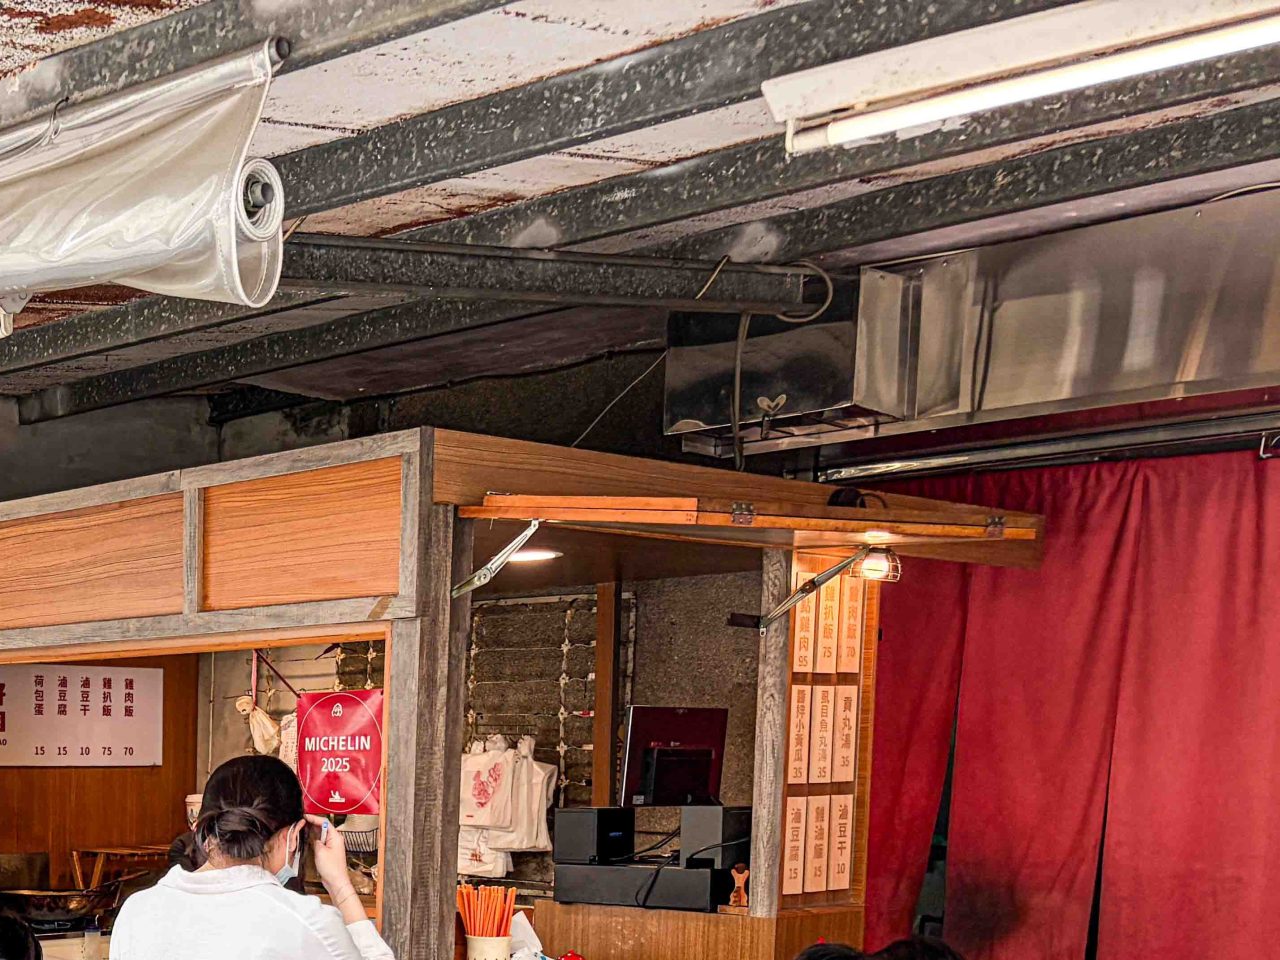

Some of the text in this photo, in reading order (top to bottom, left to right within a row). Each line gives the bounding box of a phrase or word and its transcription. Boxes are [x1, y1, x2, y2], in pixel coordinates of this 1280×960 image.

[822, 646, 832, 658] 75
[846, 646, 856, 658] 70
[798, 655, 808, 667] 95
[34, 675, 45, 716] 荷包蛋
[57, 676, 68, 716] 滷豆腐
[80, 677, 91, 716] 滷豆干
[102, 677, 112, 717] 雞扒飯
[124, 678, 134, 717] 雞肉飯
[305, 736, 370, 751] MICHELIN
[34, 746, 45, 756] 15
[57, 746, 68, 756] 15
[80, 746, 90, 756] 10
[102, 746, 112, 756] 75
[124, 746, 134, 756] 70
[321, 757, 350, 772] 2025
[840, 756, 850, 767] 35
[792, 767, 803, 778] 35
[817, 766, 827, 778] 35
[837, 804, 849, 857] 滷豆干
[789, 868, 798, 880] 15
[813, 865, 822, 878] 15
[836, 862, 846, 874] 10
